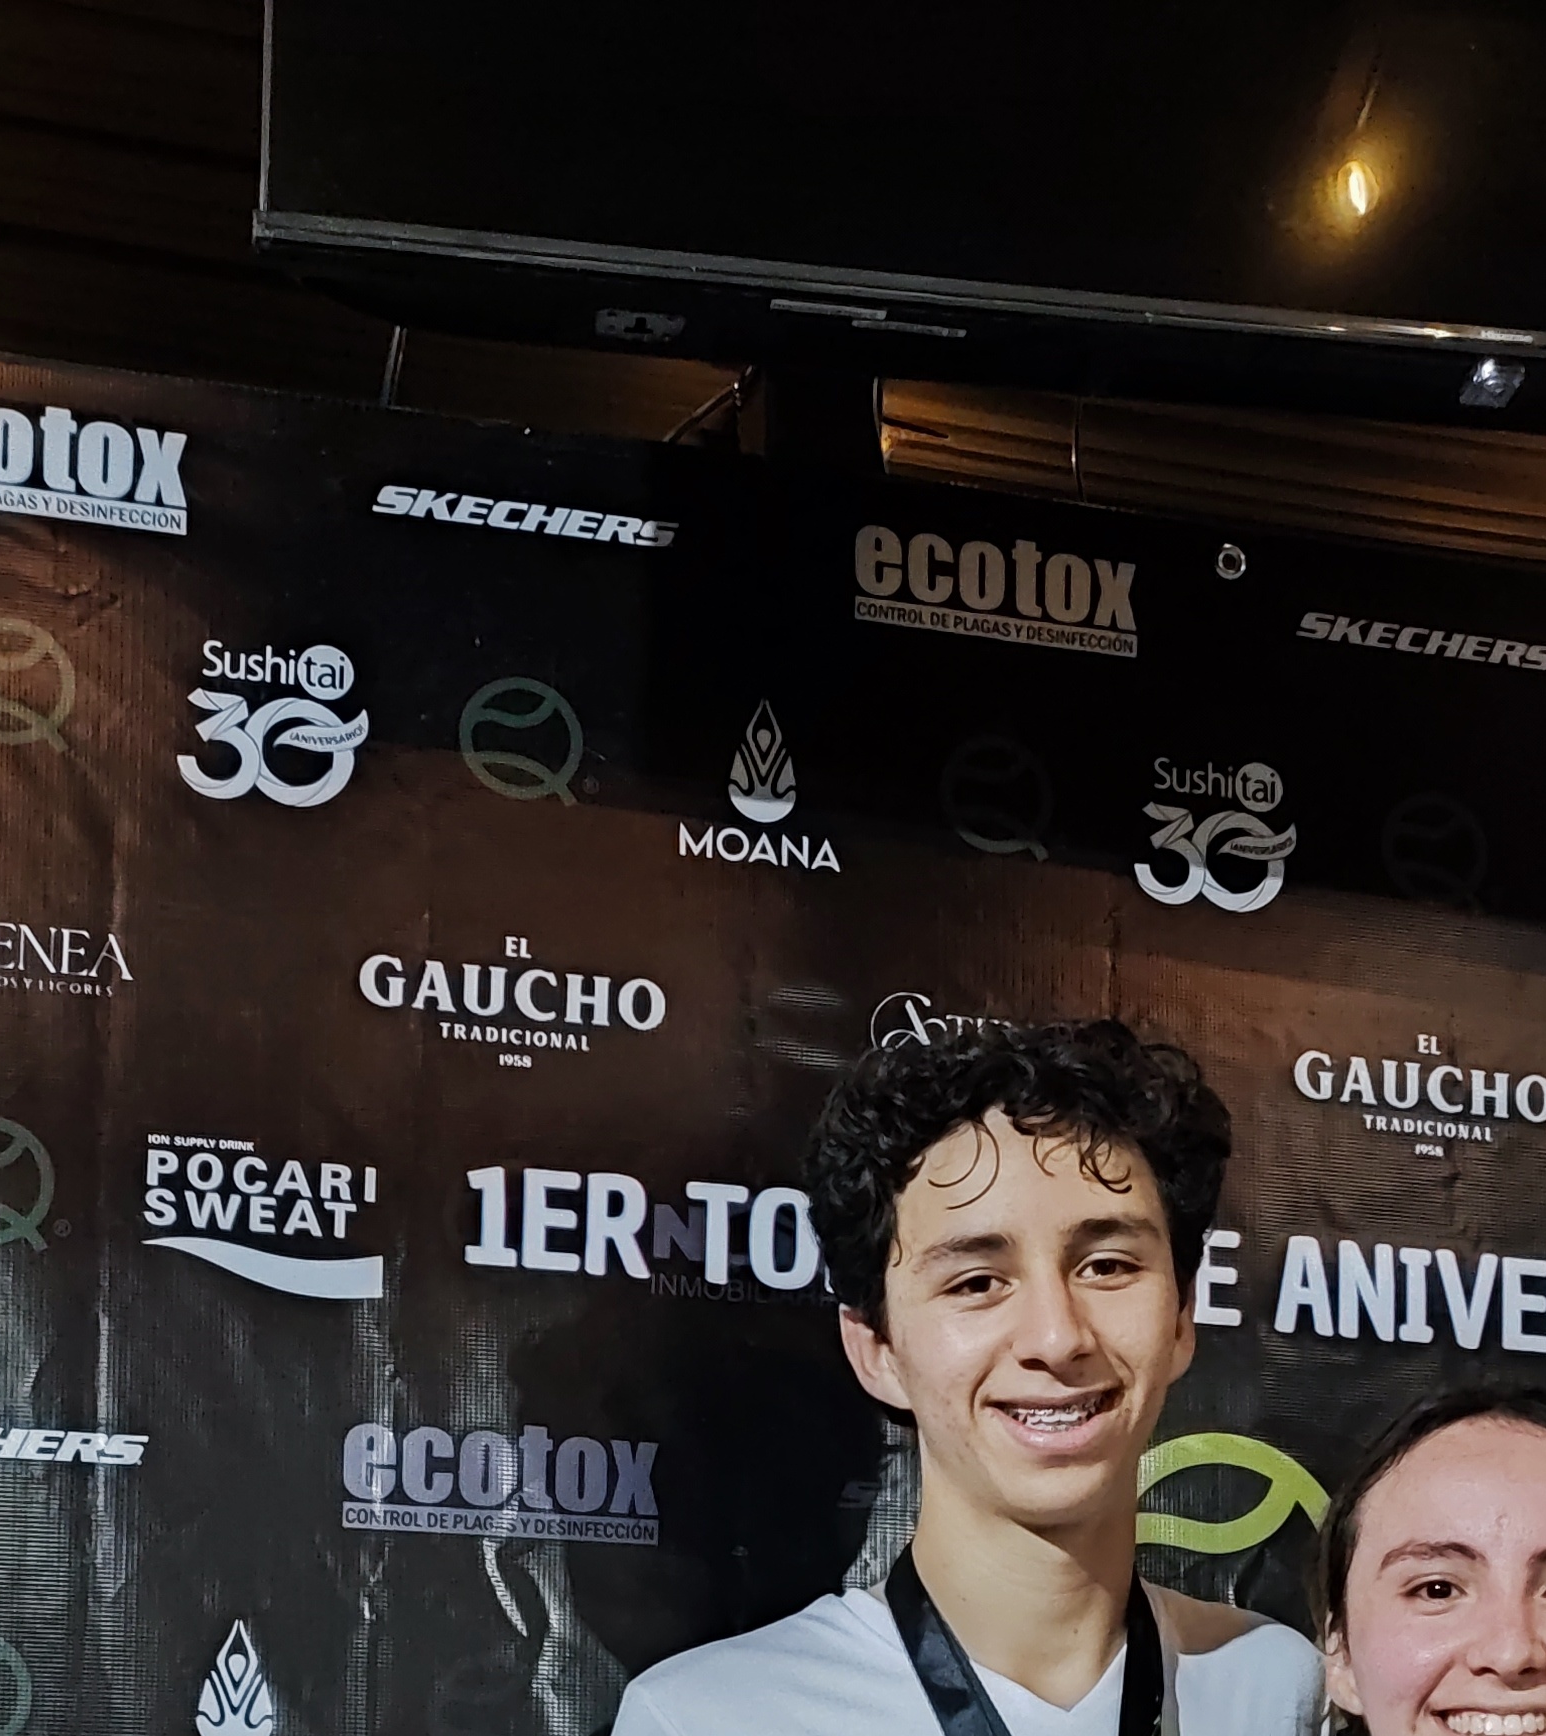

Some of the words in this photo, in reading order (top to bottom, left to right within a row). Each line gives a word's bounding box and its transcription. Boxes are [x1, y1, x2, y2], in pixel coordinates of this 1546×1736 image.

[42, 493, 53, 510] Y
[372, 485, 679, 547] SKECHERS
[855, 525, 1137, 631] ecotox
[856, 601, 926, 625] CONTROL
[930, 611, 950, 628] DE
[954, 616, 1011, 638] PLAGAS
[1013, 623, 1023, 638] Y
[678, 822, 841, 874] MOANA
[505, 935, 532, 959] EL
[359, 954, 666, 1031] GAUCHO
[439, 1021, 591, 1052] TRADICIONAL
[1416, 1034, 1441, 1055] EL
[498, 1053, 532, 1068] 1958
[148, 1133, 171, 1145] ION
[174, 1135, 217, 1149] SUPPLY
[218, 1139, 255, 1151] DRINK
[1363, 1114, 1494, 1142] TRADICIONAL
[1415, 1143, 1445, 1158] 1958
[146, 1148, 377, 1204] POCARI
[143, 1188, 358, 1239] SWEAT
[465, 1166, 652, 1281] 1ER
[1193, 1230, 1242, 1327] E
[343, 1422, 659, 1516] ecotox
[427, 1511, 449, 1529] DE
[519, 1517, 531, 1534] Y
